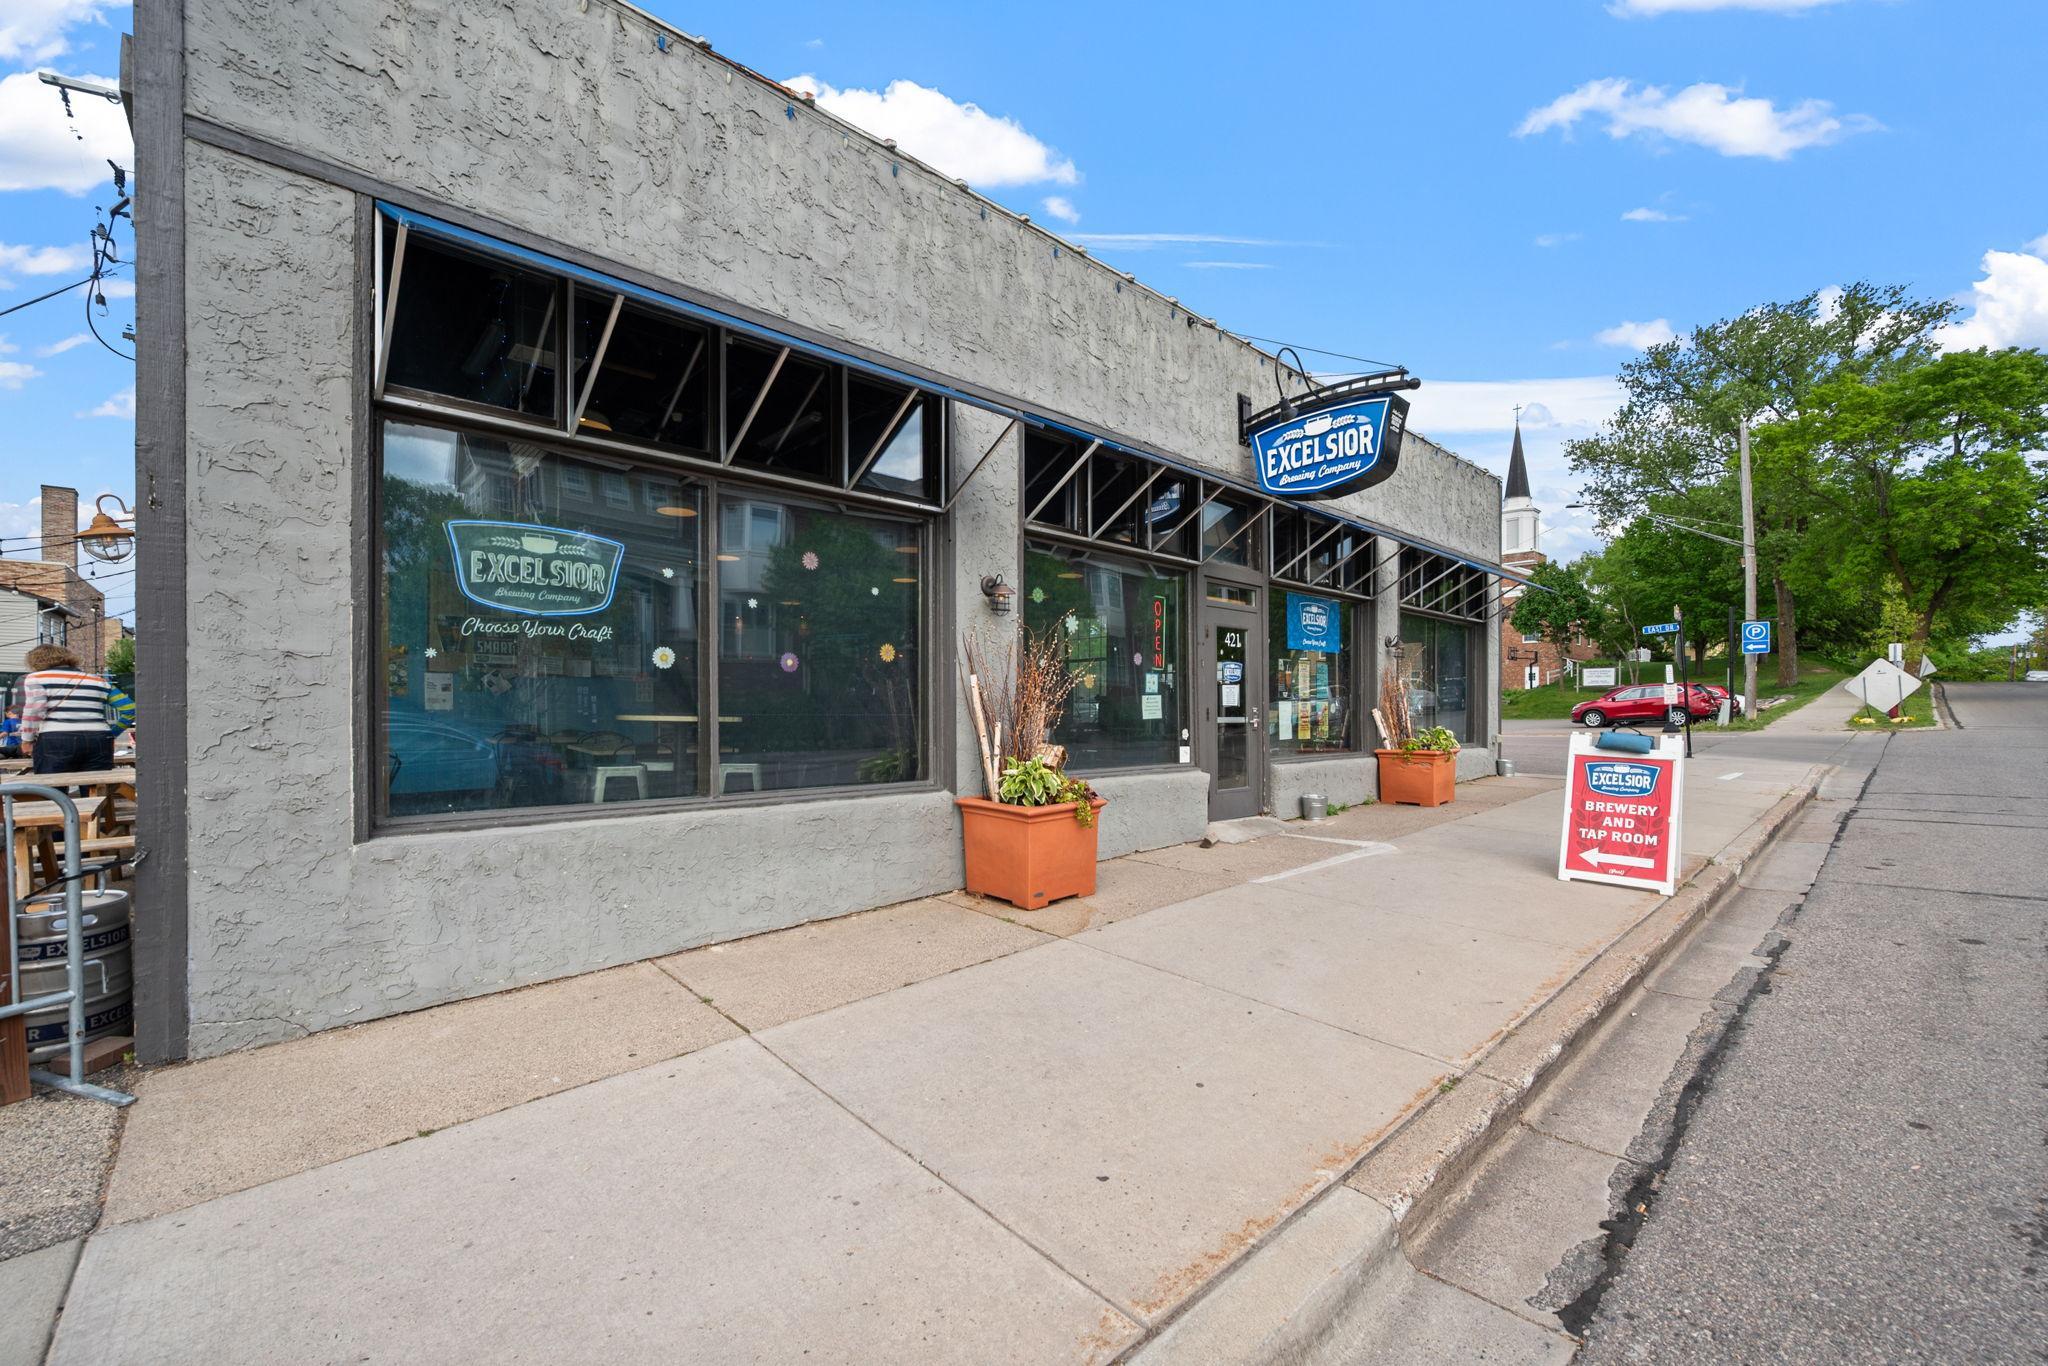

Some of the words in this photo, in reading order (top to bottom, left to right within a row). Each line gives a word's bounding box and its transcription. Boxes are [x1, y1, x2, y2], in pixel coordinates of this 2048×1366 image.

[1266, 424, 1375, 479] EXCELSIOR
[1279, 469, 1316, 486] Brewing
[1318, 459, 1362, 478] Company
[471, 550, 606, 594] EXCELSIOR
[494, 586, 536, 601] Brewing
[538, 590, 582, 605] Company
[461, 617, 521, 636] Choose
[522, 619, 566, 638] Your
[568, 622, 614, 643] Craft
[1153, 600, 1163, 668] OPEN
[1751, 627, 1762, 637] P
[477, 640, 515, 655] SMART
[1224, 632, 1242, 648] 421
[1592, 772, 1651, 790] EXCELSIOR
[1585, 801, 1659, 816] BREWERY
[1602, 817, 1635, 829] AND
[1579, 828, 1608, 840] TAP
[1611, 831, 1658, 846] ROOM
[46, 927, 128, 957] EXELSIOR
